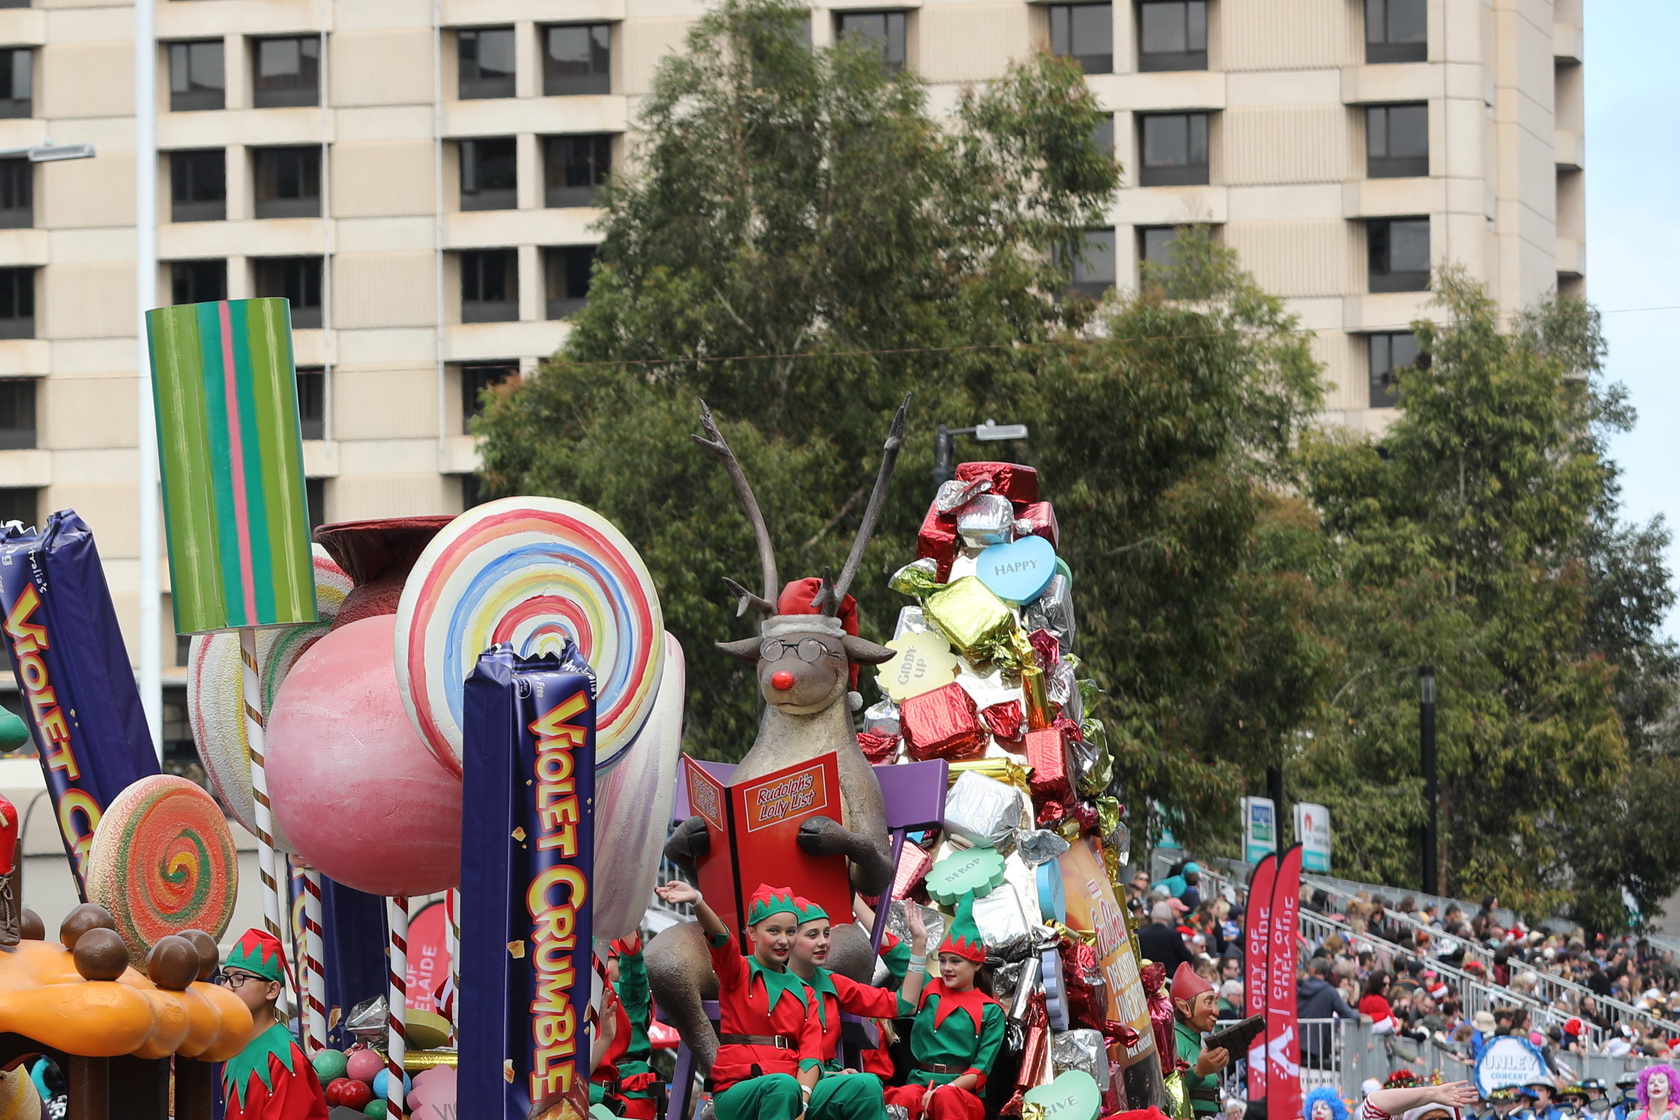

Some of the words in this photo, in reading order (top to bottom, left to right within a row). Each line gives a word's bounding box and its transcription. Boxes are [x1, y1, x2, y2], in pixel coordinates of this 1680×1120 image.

[994, 559, 1039, 577] HAPPY
[3, 581, 81, 781] VIOLET
[914, 658, 928, 679] UP
[527, 690, 590, 858] VIOLET
[756, 773, 814, 806] Rudolph's
[759, 800, 789, 822] Lolly
[789, 791, 817, 812] List
[1251, 927, 1260, 955] OF
[1274, 916, 1283, 944] OF
[526, 864, 589, 1103] CRUMBLE
[1252, 963, 1263, 1010] CITY
[1273, 952, 1283, 1000] CITY
[1484, 1056, 1538, 1071] UNLEY
